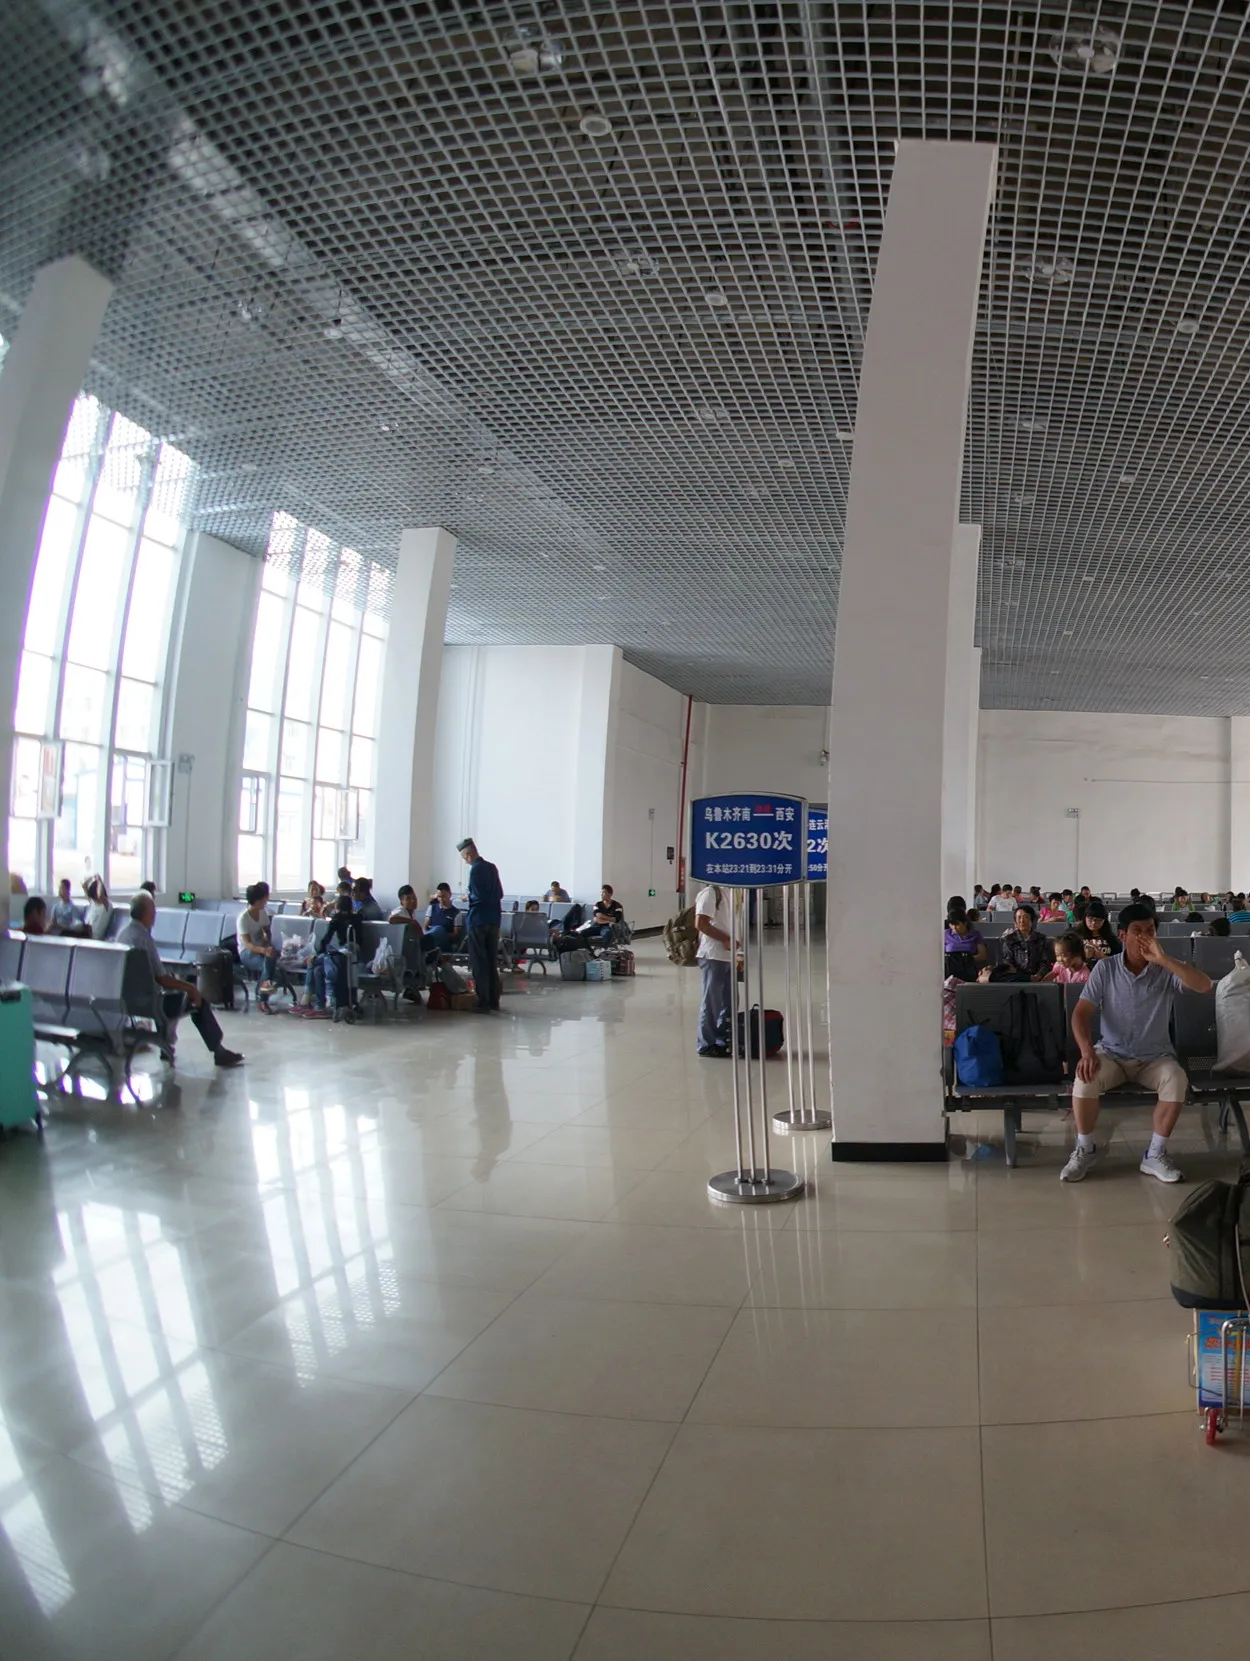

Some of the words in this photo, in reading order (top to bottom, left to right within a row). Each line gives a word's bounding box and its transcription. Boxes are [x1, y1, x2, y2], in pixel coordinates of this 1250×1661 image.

[704, 806, 751, 822] 乌鲁木齐南
[775, 807, 795, 821] 西安
[705, 830, 793, 850] K2630次
[706, 863, 792, 874] 在本站23:21到23:31分开
